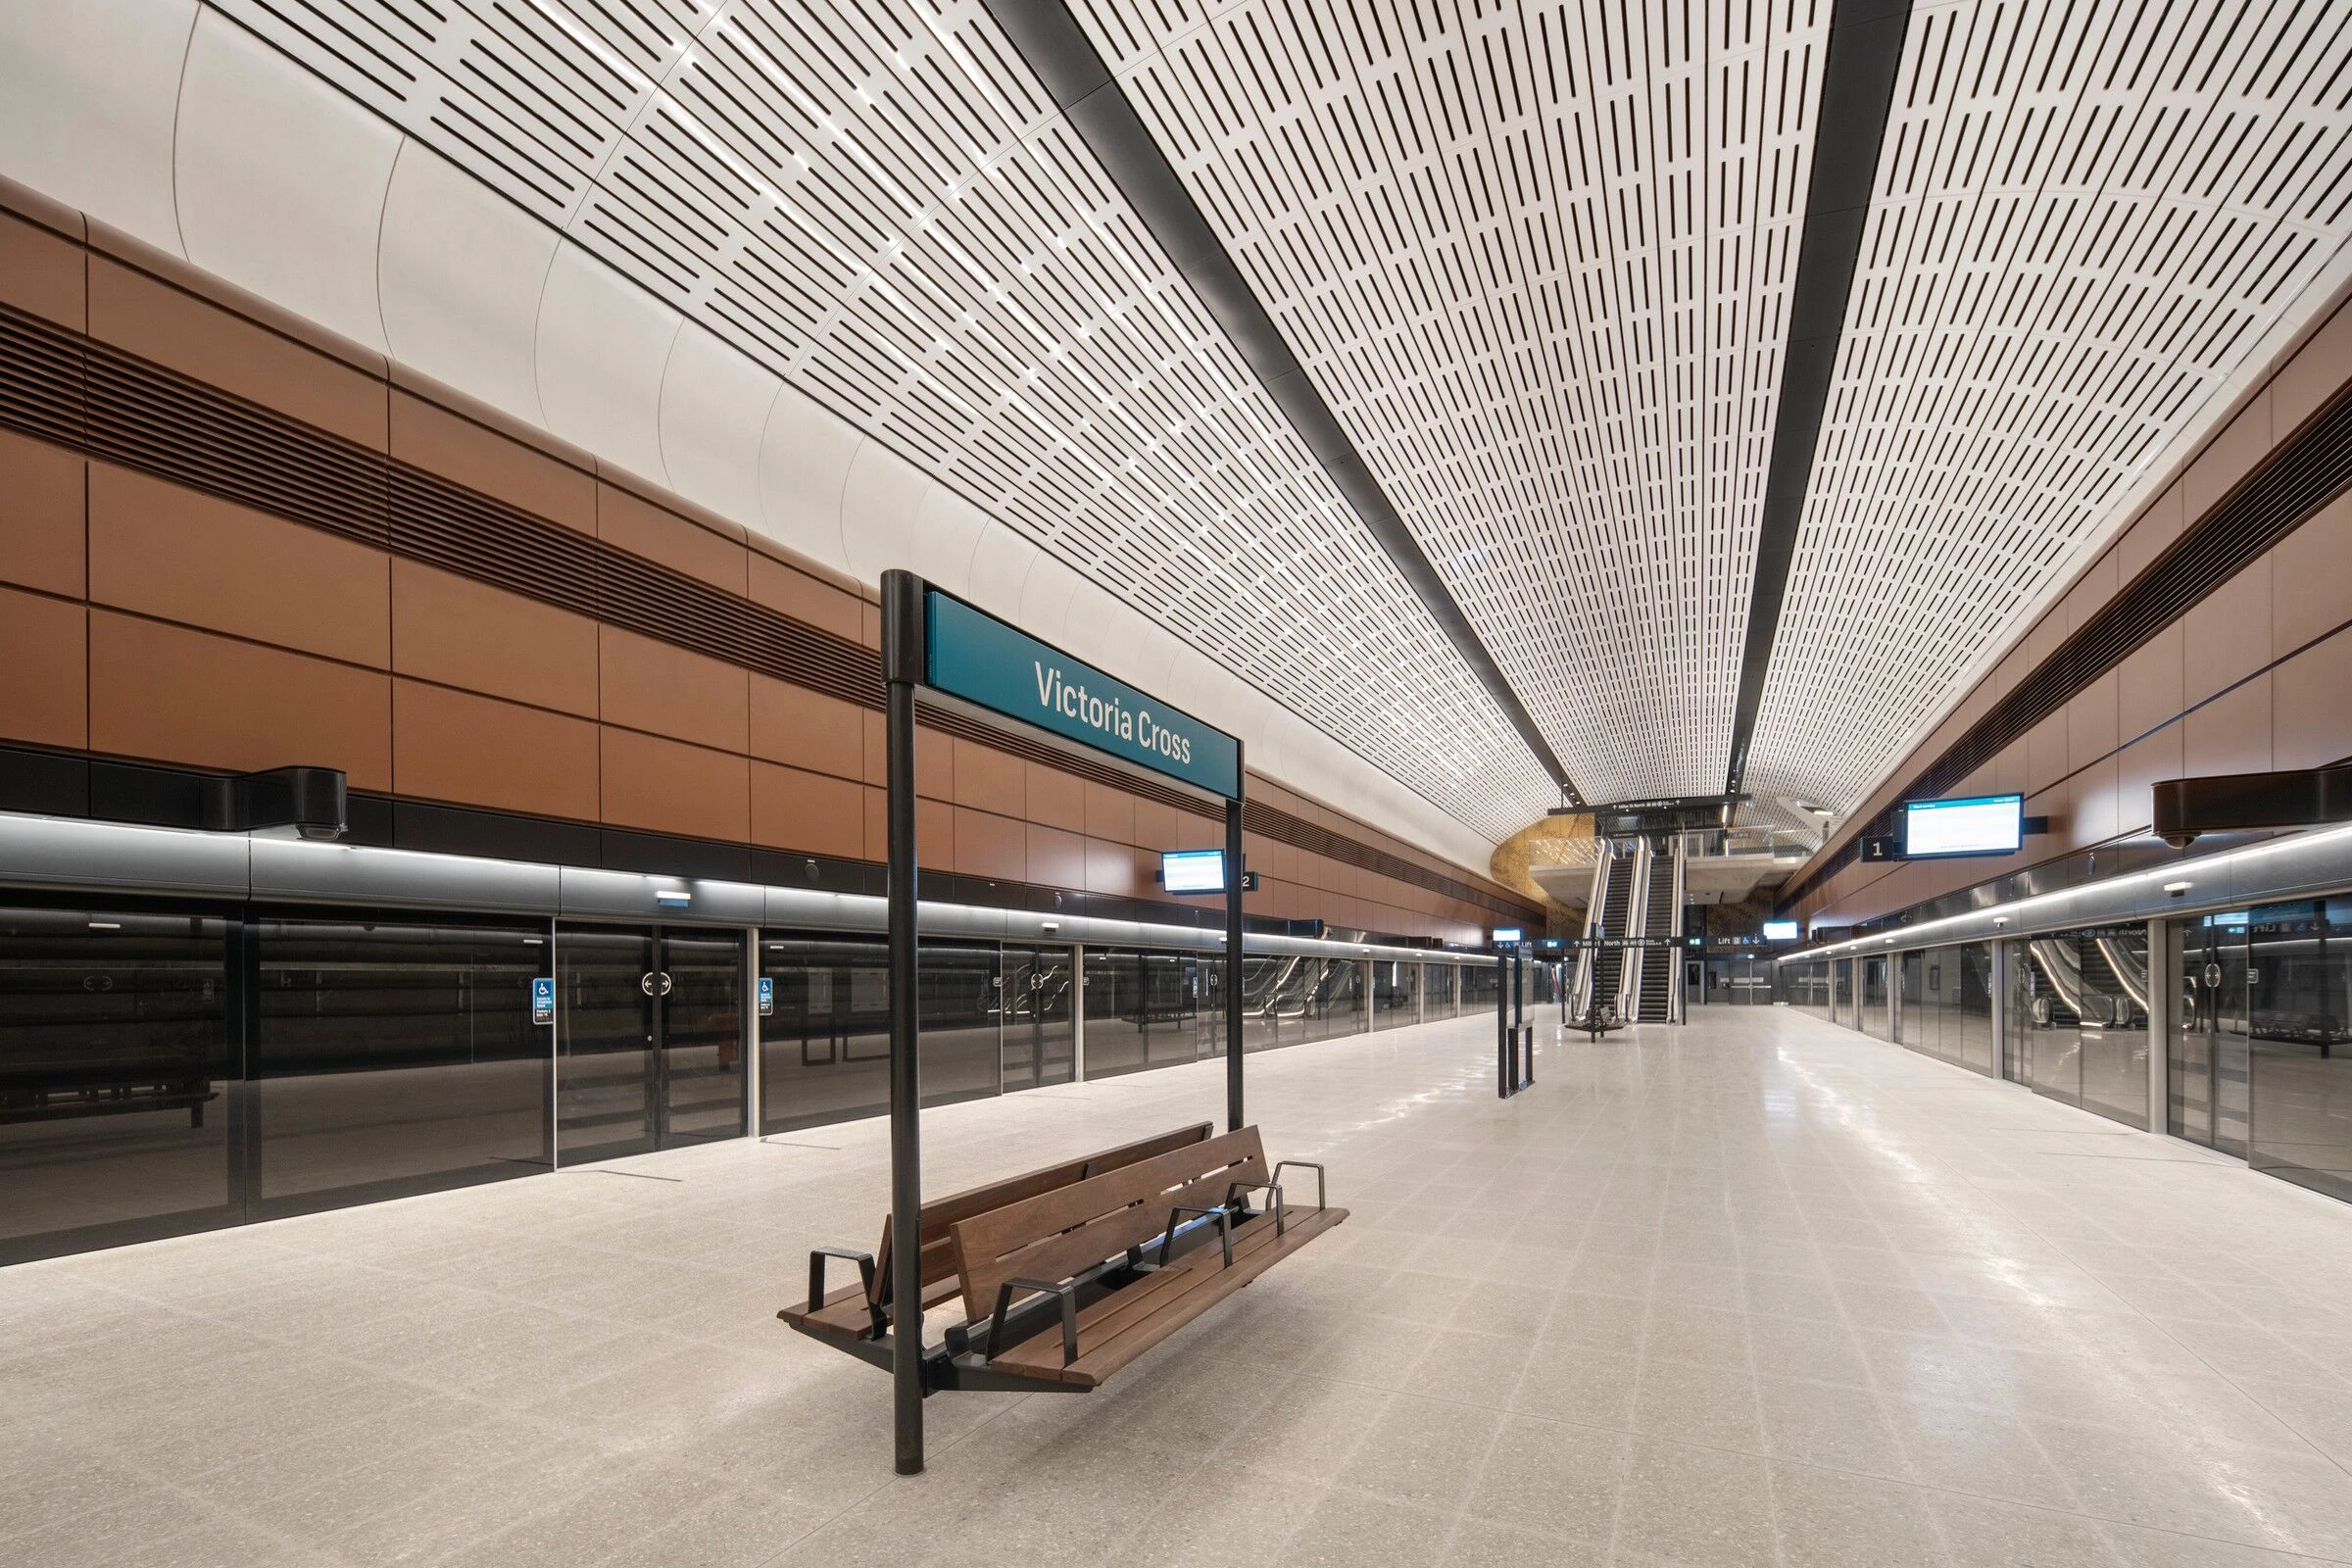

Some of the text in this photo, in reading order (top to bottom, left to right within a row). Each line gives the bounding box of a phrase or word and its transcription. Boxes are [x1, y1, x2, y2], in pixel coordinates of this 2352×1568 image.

[1035, 661, 1190, 764] Victoria Cross
[1873, 842, 1883, 857] 1
[1242, 876, 1250, 887] 2
